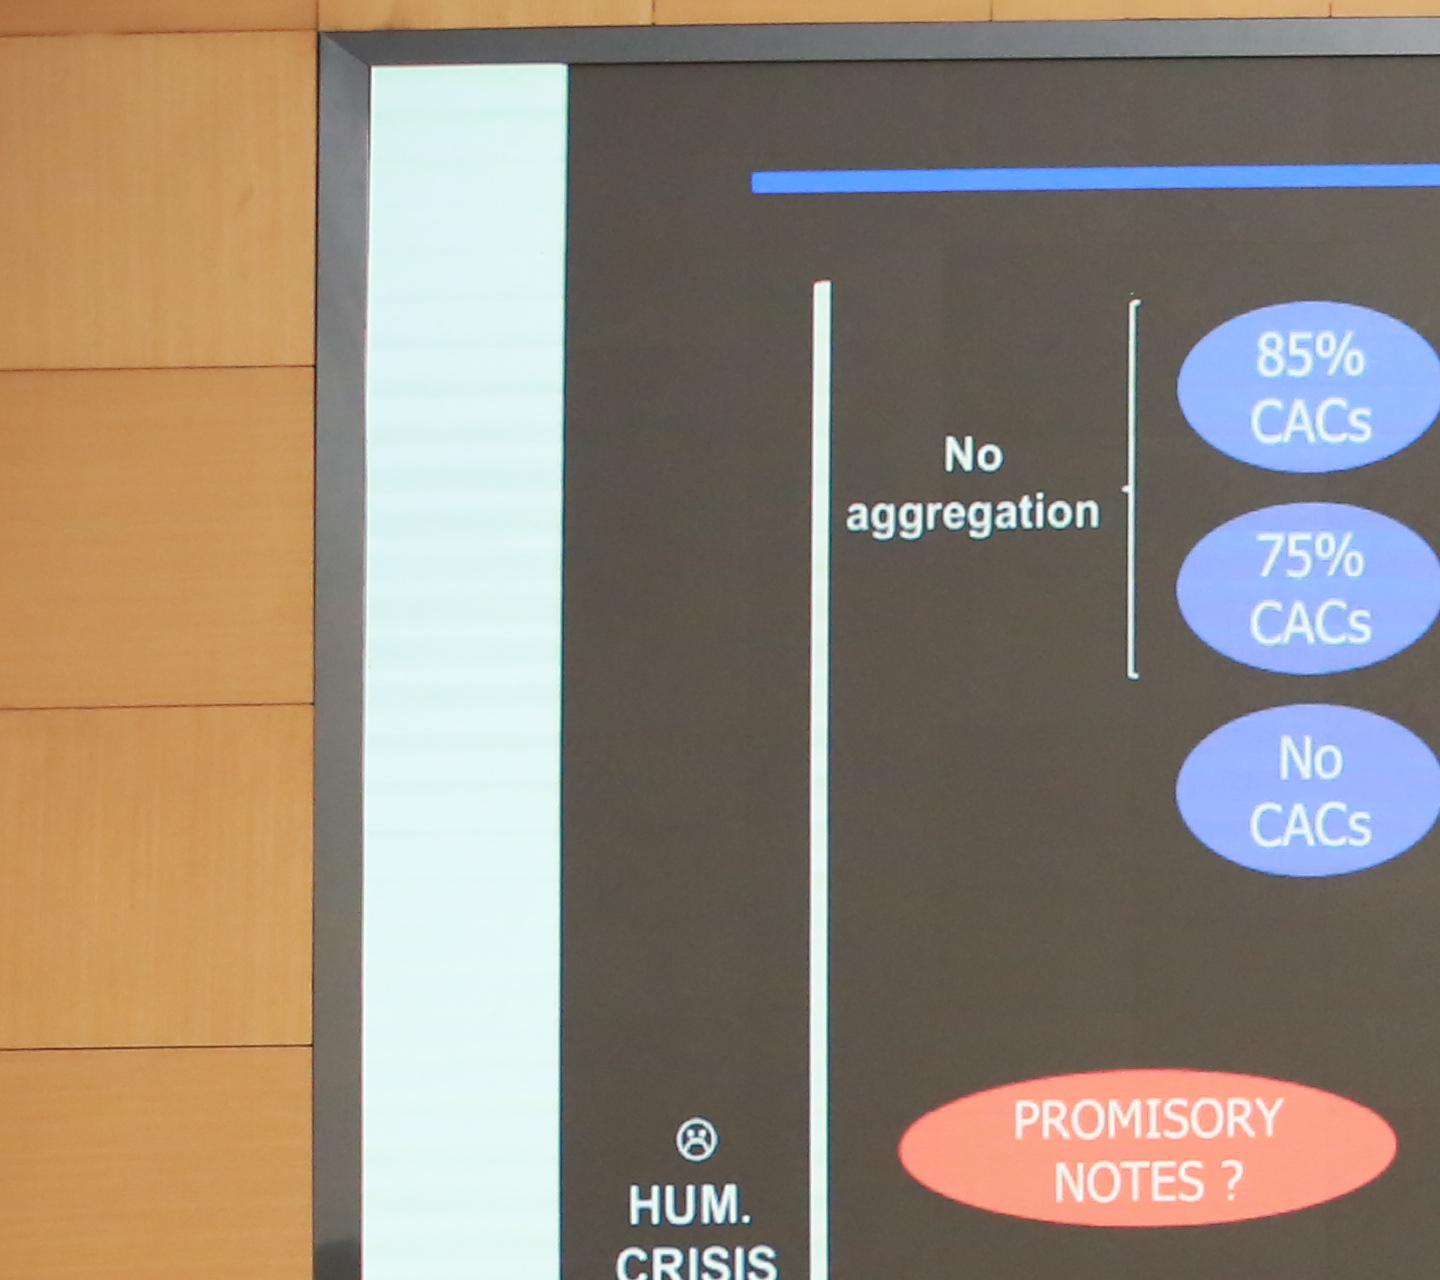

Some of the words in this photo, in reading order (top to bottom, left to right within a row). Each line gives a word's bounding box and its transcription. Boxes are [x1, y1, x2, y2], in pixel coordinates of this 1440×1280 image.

[1258, 331, 1367, 379] 85%
[1252, 397, 1374, 446] CACs
[946, 436, 1004, 473] No
[847, 493, 1100, 541] aggregation
[1257, 532, 1366, 580] 75%
[1251, 599, 1374, 647] CACs
[1281, 736, 1344, 781] No
[1251, 802, 1374, 849] CACs
[1016, 1098, 1285, 1142] PROMISORY
[631, 1184, 751, 1226] HUM.
[1056, 1161, 1206, 1205] NOTES
[1222, 1160, 1245, 1202] ?
